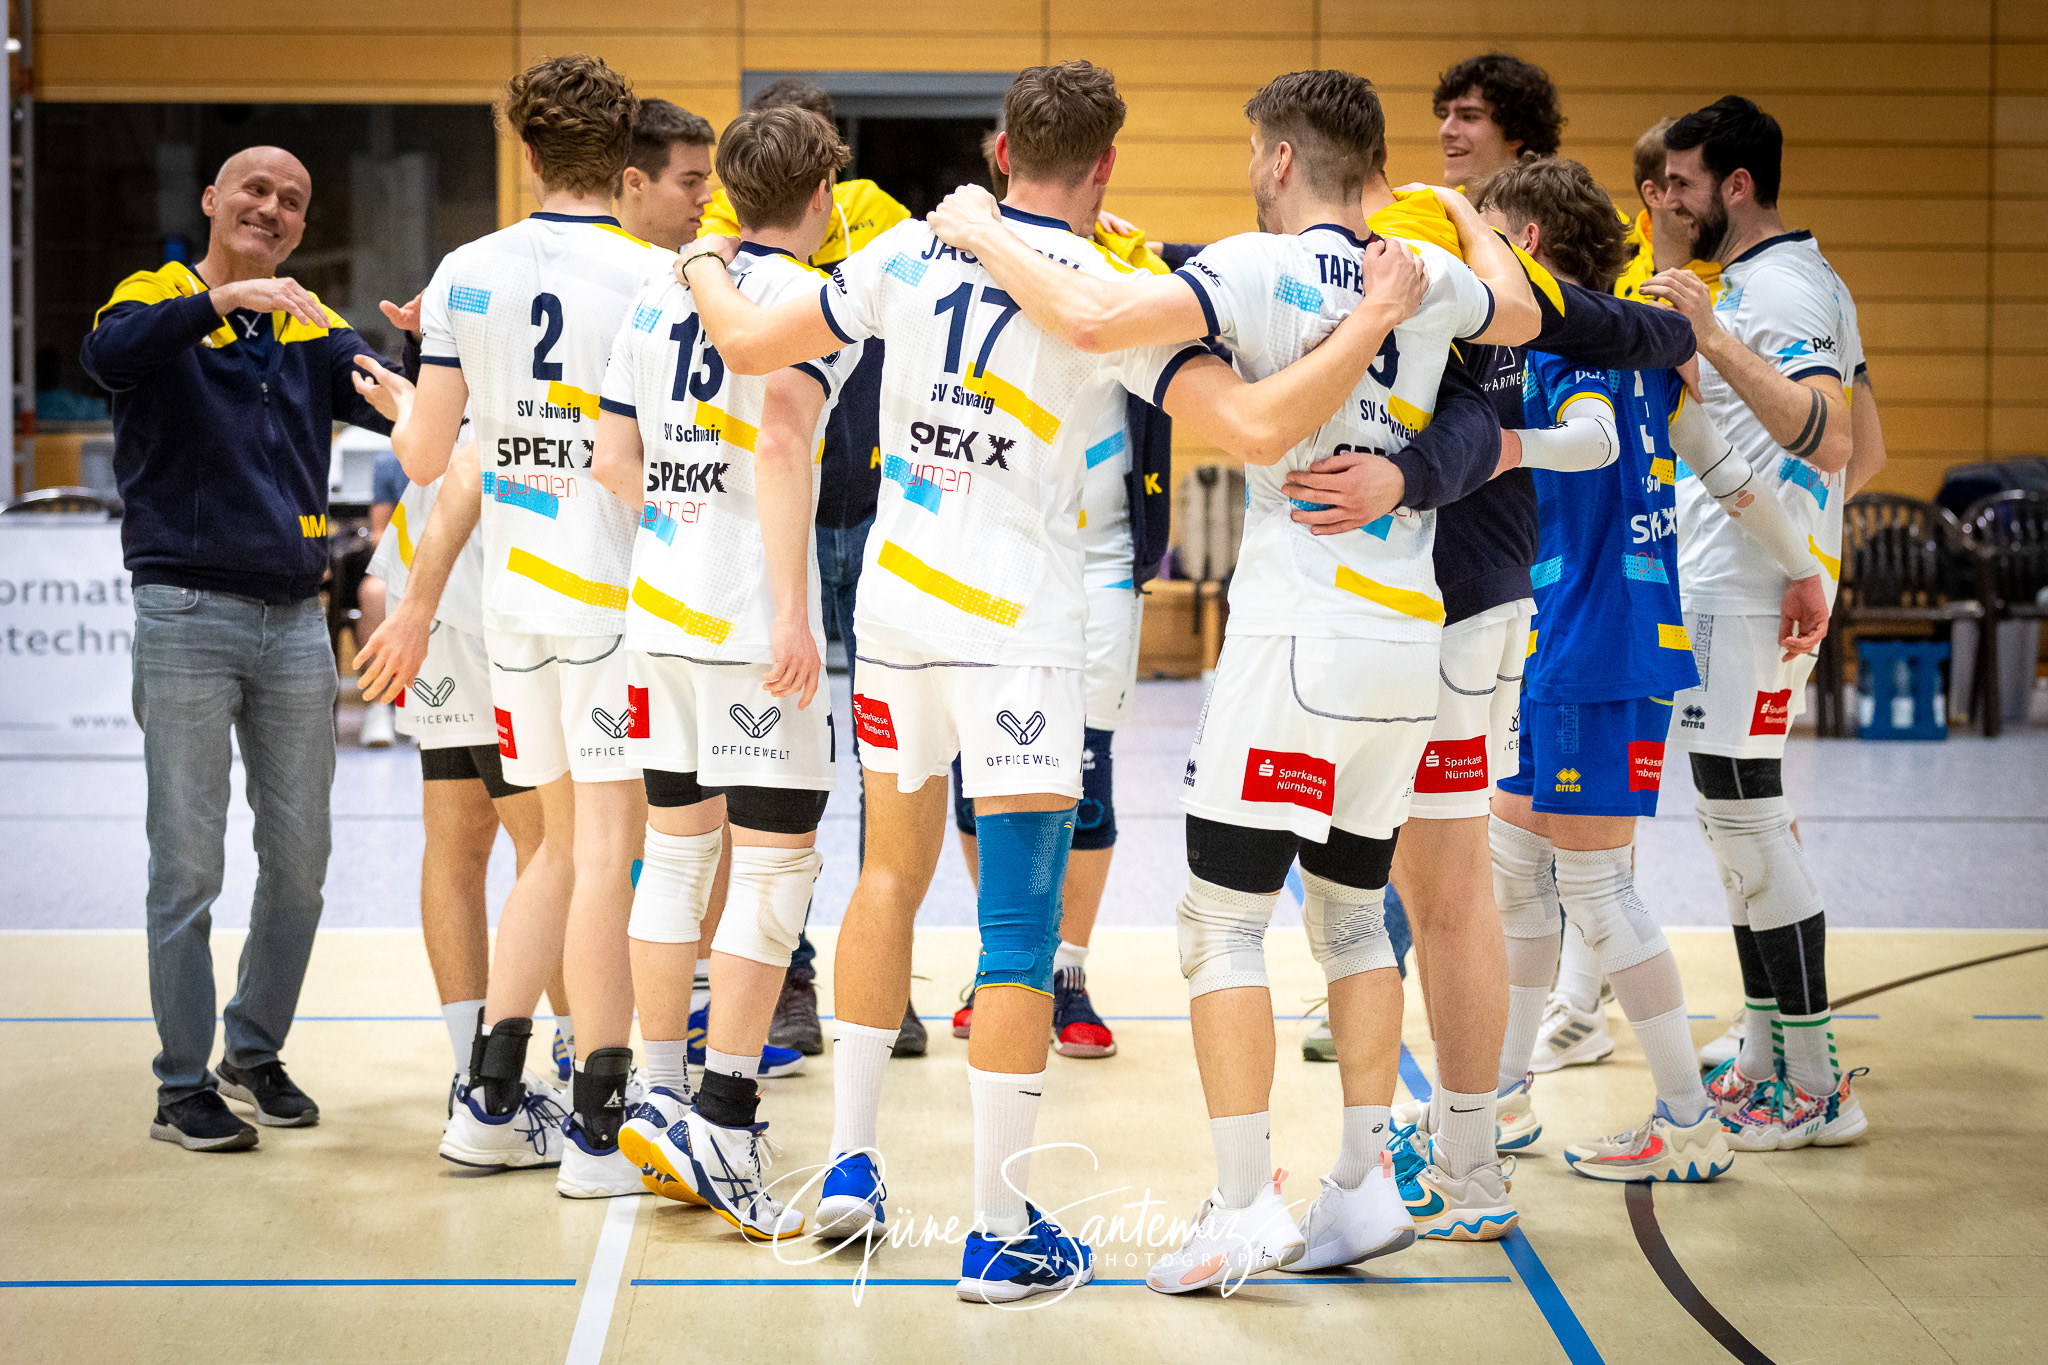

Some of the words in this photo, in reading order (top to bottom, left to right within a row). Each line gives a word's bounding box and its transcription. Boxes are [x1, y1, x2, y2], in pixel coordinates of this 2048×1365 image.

[1315, 254, 1364, 297] TAFE
[531, 293, 564, 381] 2
[934, 282, 1021, 378] 17
[952, 385, 995, 414] Swaig
[1360, 399, 1376, 421] SV
[517, 400, 533, 416] SV
[539, 402, 580, 423] chwaig
[0, 621, 132, 655] techn
[415, 713, 474, 724] FICEWELT
[712, 745, 790, 761] OFFICEWELT
[986, 754, 1060, 768] OFFICEWELT
[1278, 768, 1327, 787] Sparkasse
[1276, 780, 1323, 800] Nürnberg
